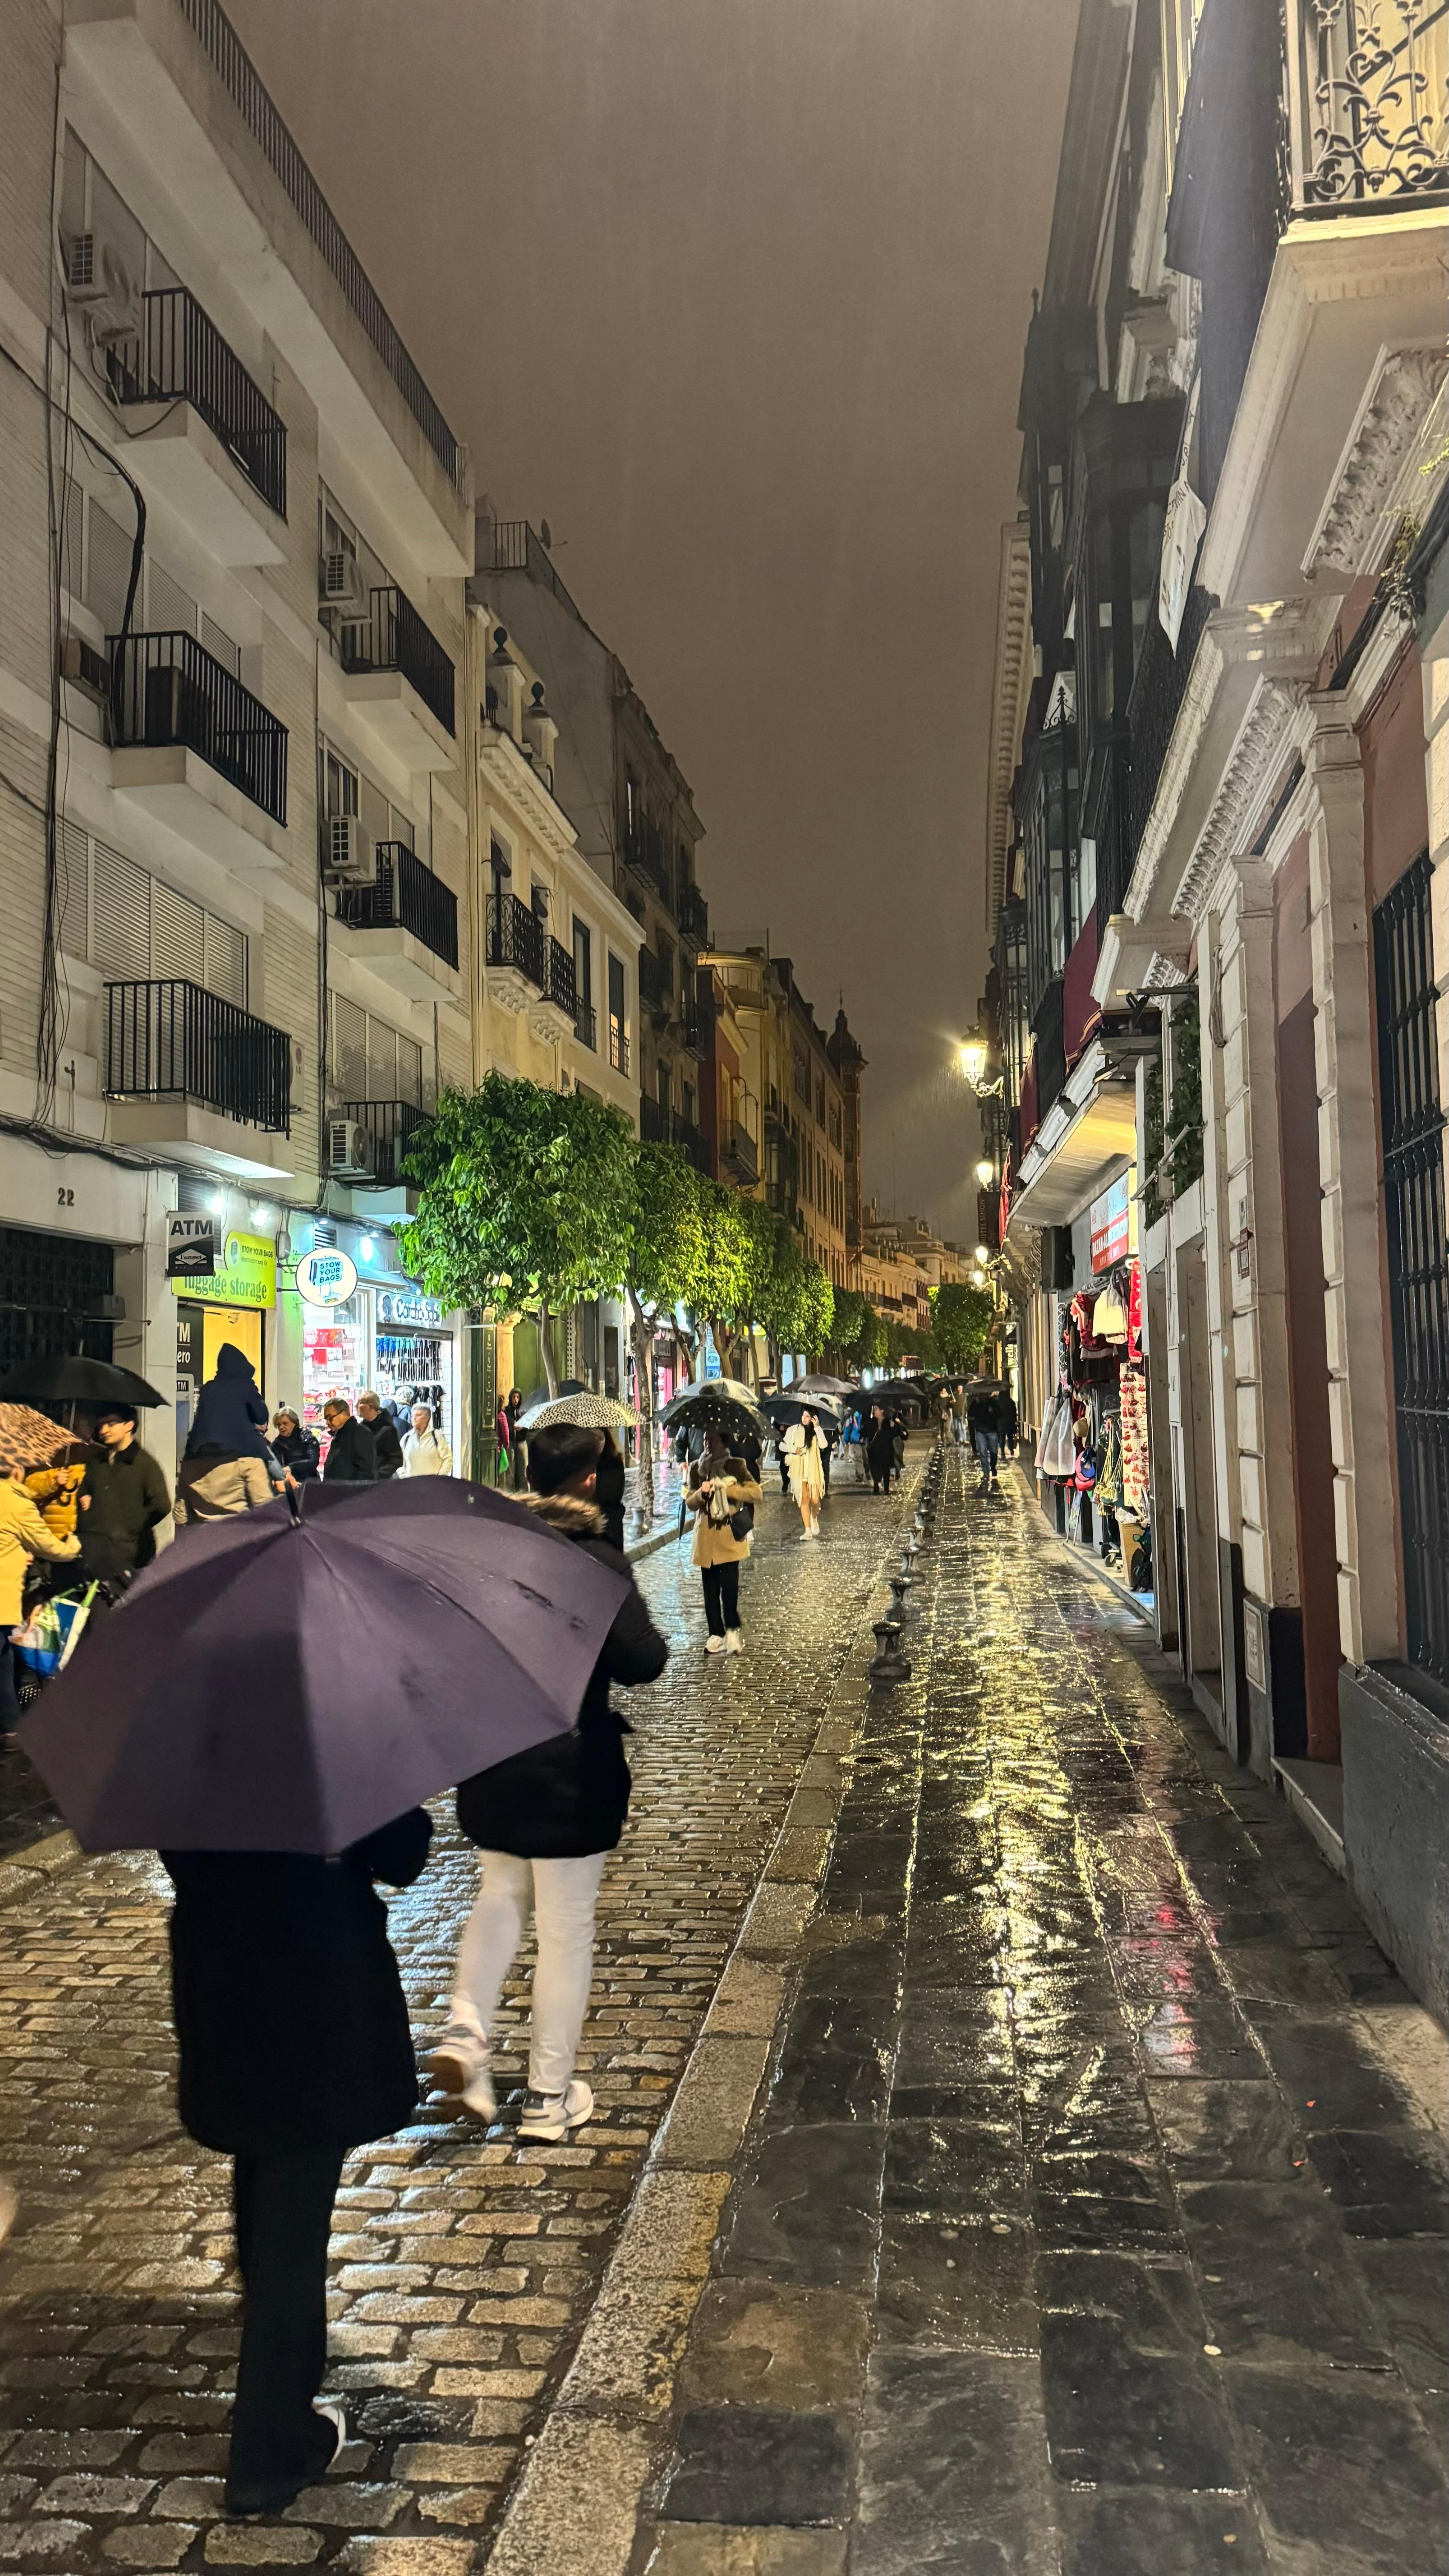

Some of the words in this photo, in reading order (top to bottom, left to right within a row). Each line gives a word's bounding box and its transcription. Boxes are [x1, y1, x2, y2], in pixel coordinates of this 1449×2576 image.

[58, 1187, 74, 1207] 22
[170, 1219, 213, 1236] ATM
[242, 1245, 253, 1254] STOW
[253, 1248, 263, 1256] YOUR
[263, 1250, 273, 1258] BAGS
[319, 1274, 340, 1283] BAGS
[320, 1267, 340, 1275] YOUR
[230, 1277, 267, 1302] storage
